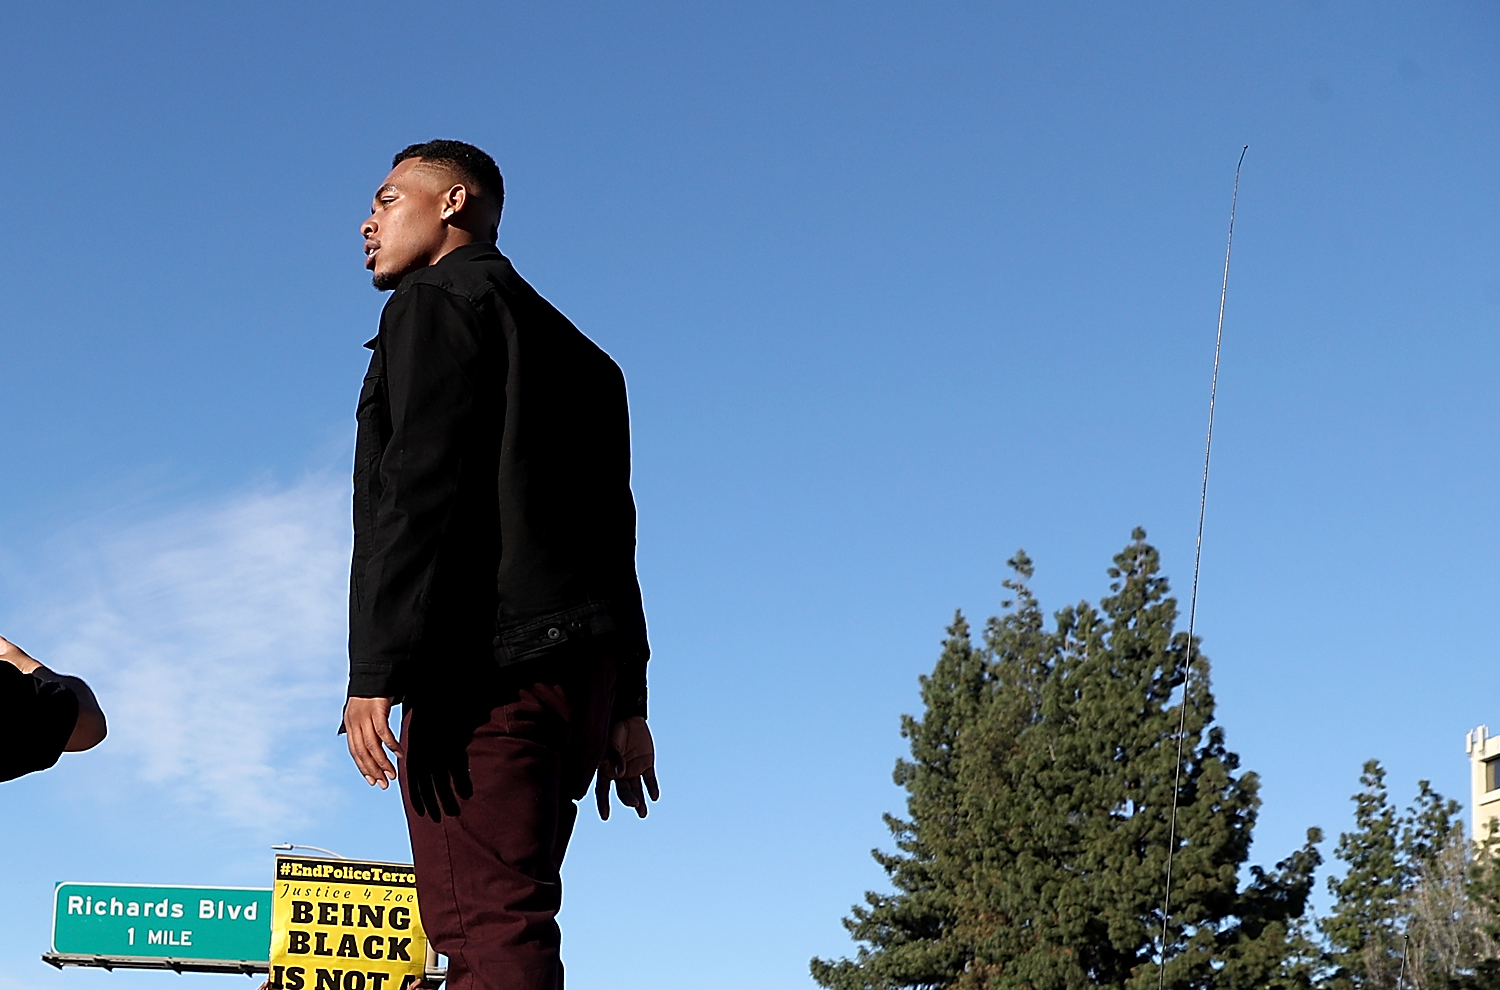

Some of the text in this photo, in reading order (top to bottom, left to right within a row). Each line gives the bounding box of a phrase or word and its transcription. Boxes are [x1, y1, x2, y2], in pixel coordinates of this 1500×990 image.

[280, 883, 415, 903] Justice 4 Zoe
[67, 895, 258, 921] Richards Blvd
[291, 900, 411, 931] BEING
[127, 926, 193, 947] 1 MILE
[287, 930, 413, 962] BLACK
[271, 965, 306, 990] IS
